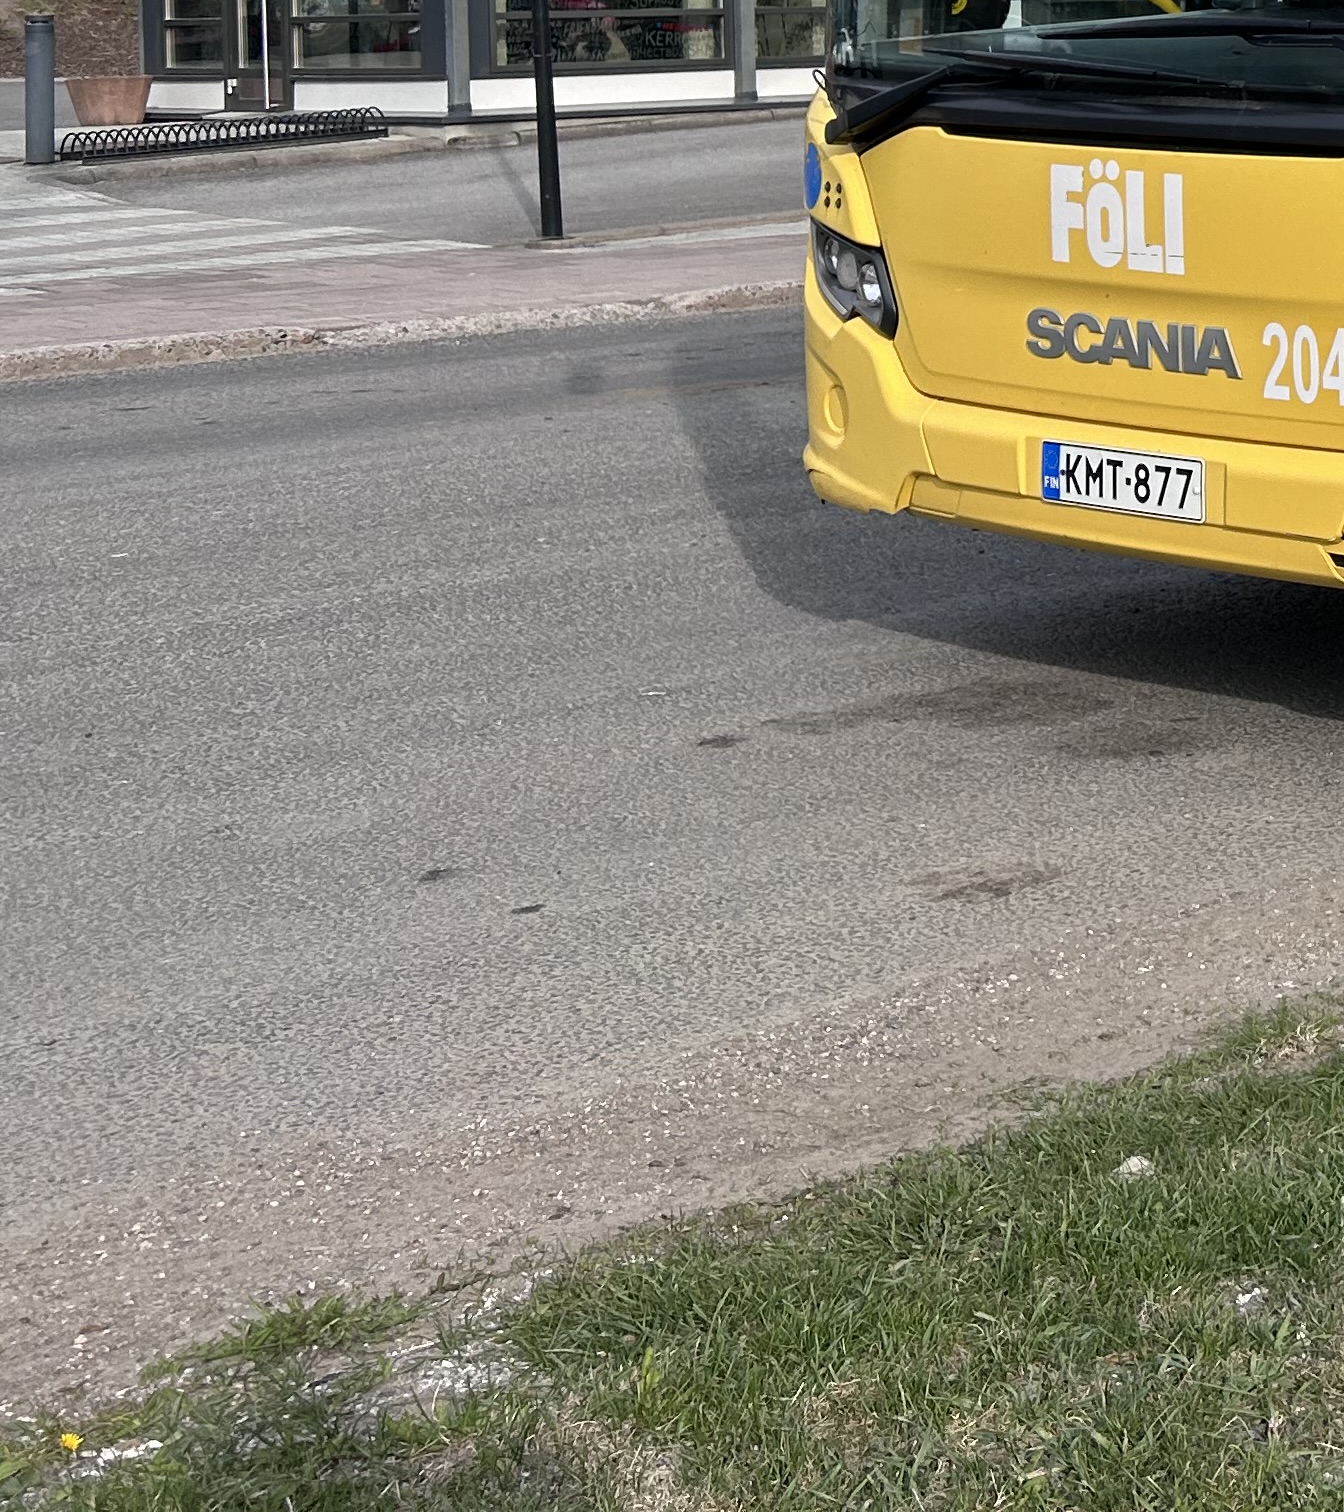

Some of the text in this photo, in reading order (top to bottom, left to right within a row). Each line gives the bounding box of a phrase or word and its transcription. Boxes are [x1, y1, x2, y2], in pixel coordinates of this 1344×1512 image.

[1050, 158, 1185, 275] FÖLI
[1026, 307, 1243, 380] SCANIA
[1044, 475, 1059, 490] FIN
[1065, 452, 1194, 510] KMT-877
